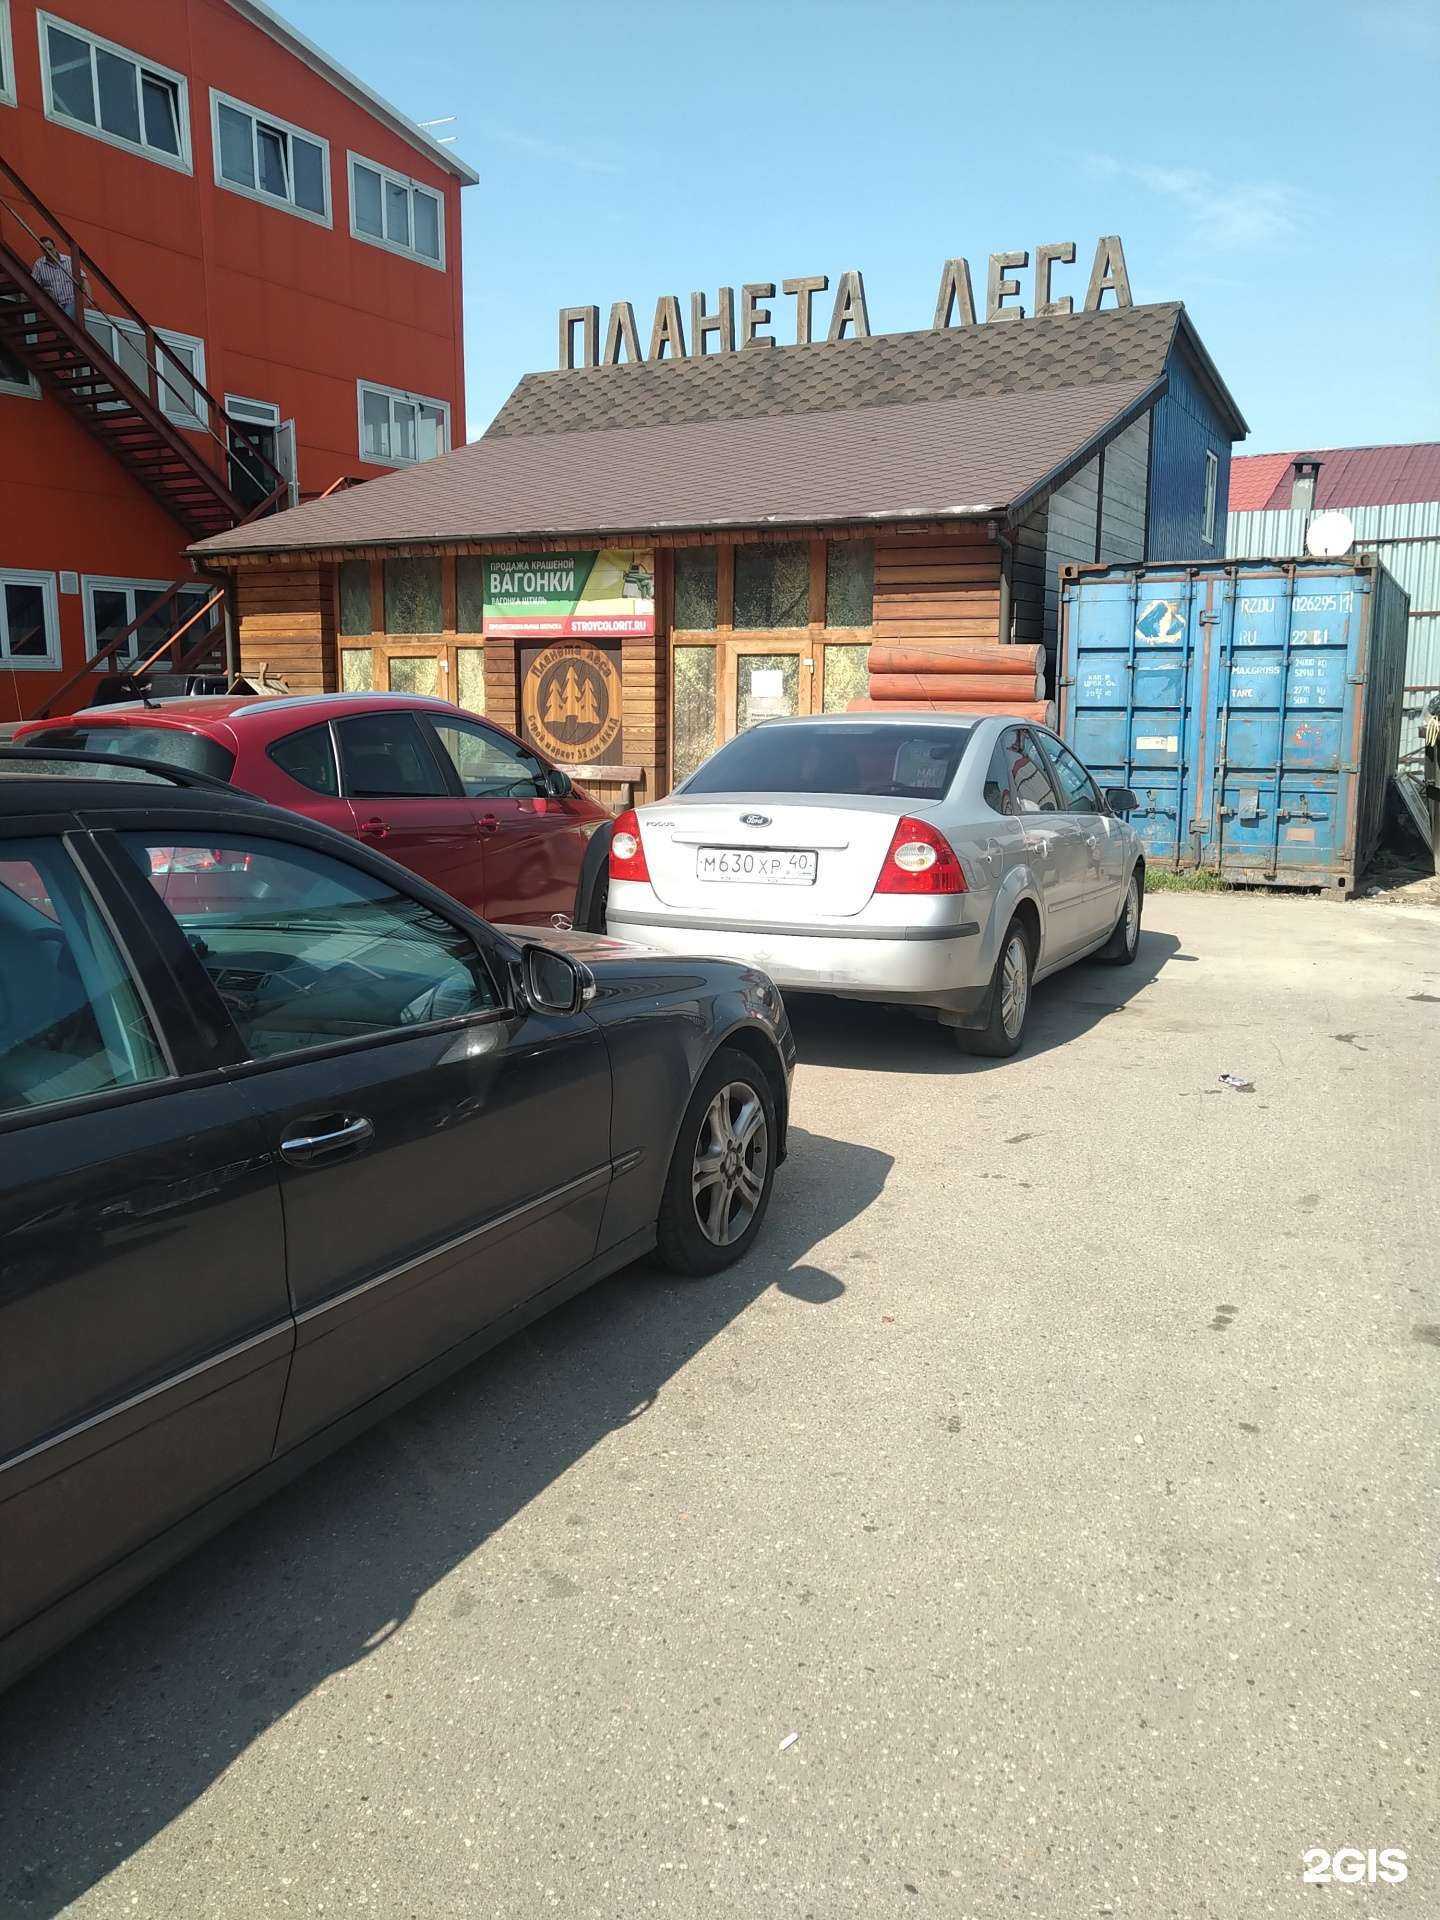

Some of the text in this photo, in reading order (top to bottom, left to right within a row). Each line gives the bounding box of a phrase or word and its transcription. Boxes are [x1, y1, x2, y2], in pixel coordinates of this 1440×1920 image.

[559, 235, 1133, 369] ПЛАНЕТА ЛЕСА
[490, 558, 575, 572] ПРОДАЖА КРАШЕНОЙ
[490, 571, 574, 593] ВАГОНКИ
[571, 620, 647, 632] STROYCOLORIT.RU
